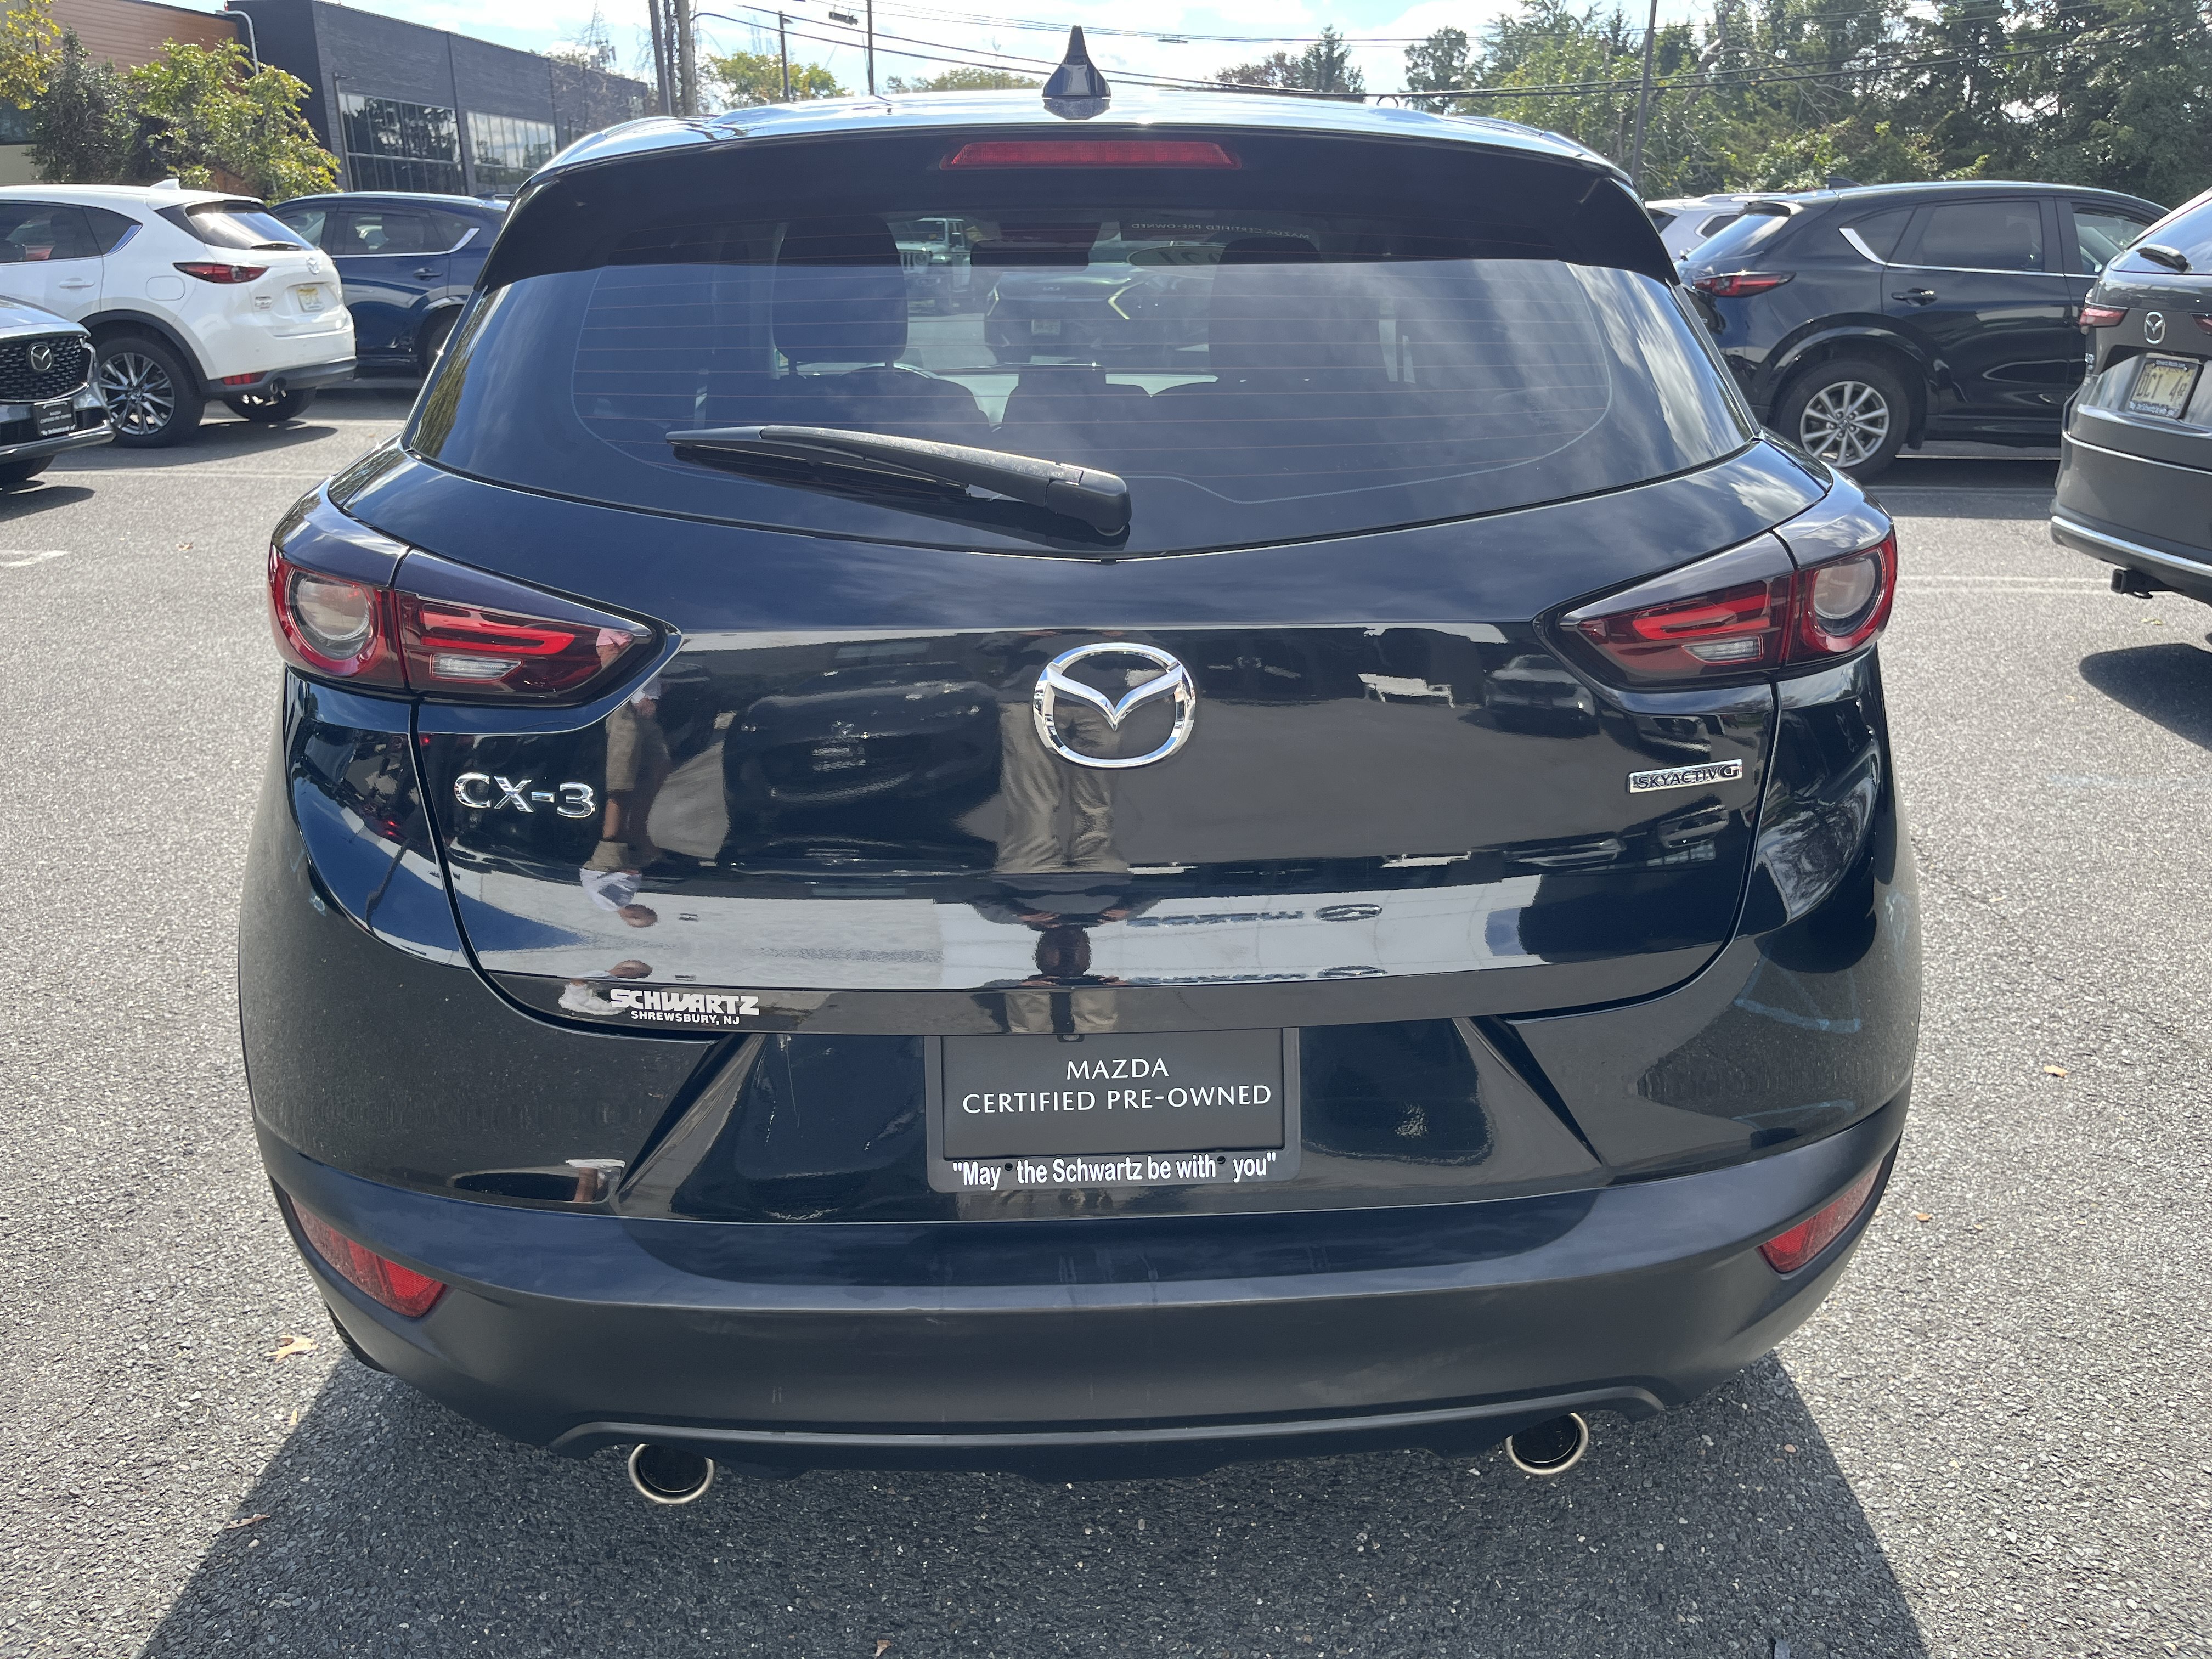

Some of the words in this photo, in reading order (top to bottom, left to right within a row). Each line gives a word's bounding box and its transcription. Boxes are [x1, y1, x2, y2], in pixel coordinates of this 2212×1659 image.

[454, 771, 596, 819] CX-3
[610, 988, 760, 1015] SCHWARTZ
[630, 1010, 720, 1025] SHREWSBURY,
[723, 1015, 740, 1025] NJ
[1066, 1058, 1169, 1080] MAZDA
[963, 1091, 1096, 1114] CERTIFIED
[1108, 1085, 1271, 1109] PRE-OWNED
[953, 1161, 1001, 1190] "May
[1016, 1159, 1047, 1184] the
[1052, 1156, 1143, 1183] Schwartz
[1148, 1155, 1171, 1180] be
[1176, 1154, 1216, 1178] with
[1233, 1152, 1276, 1183] you"
